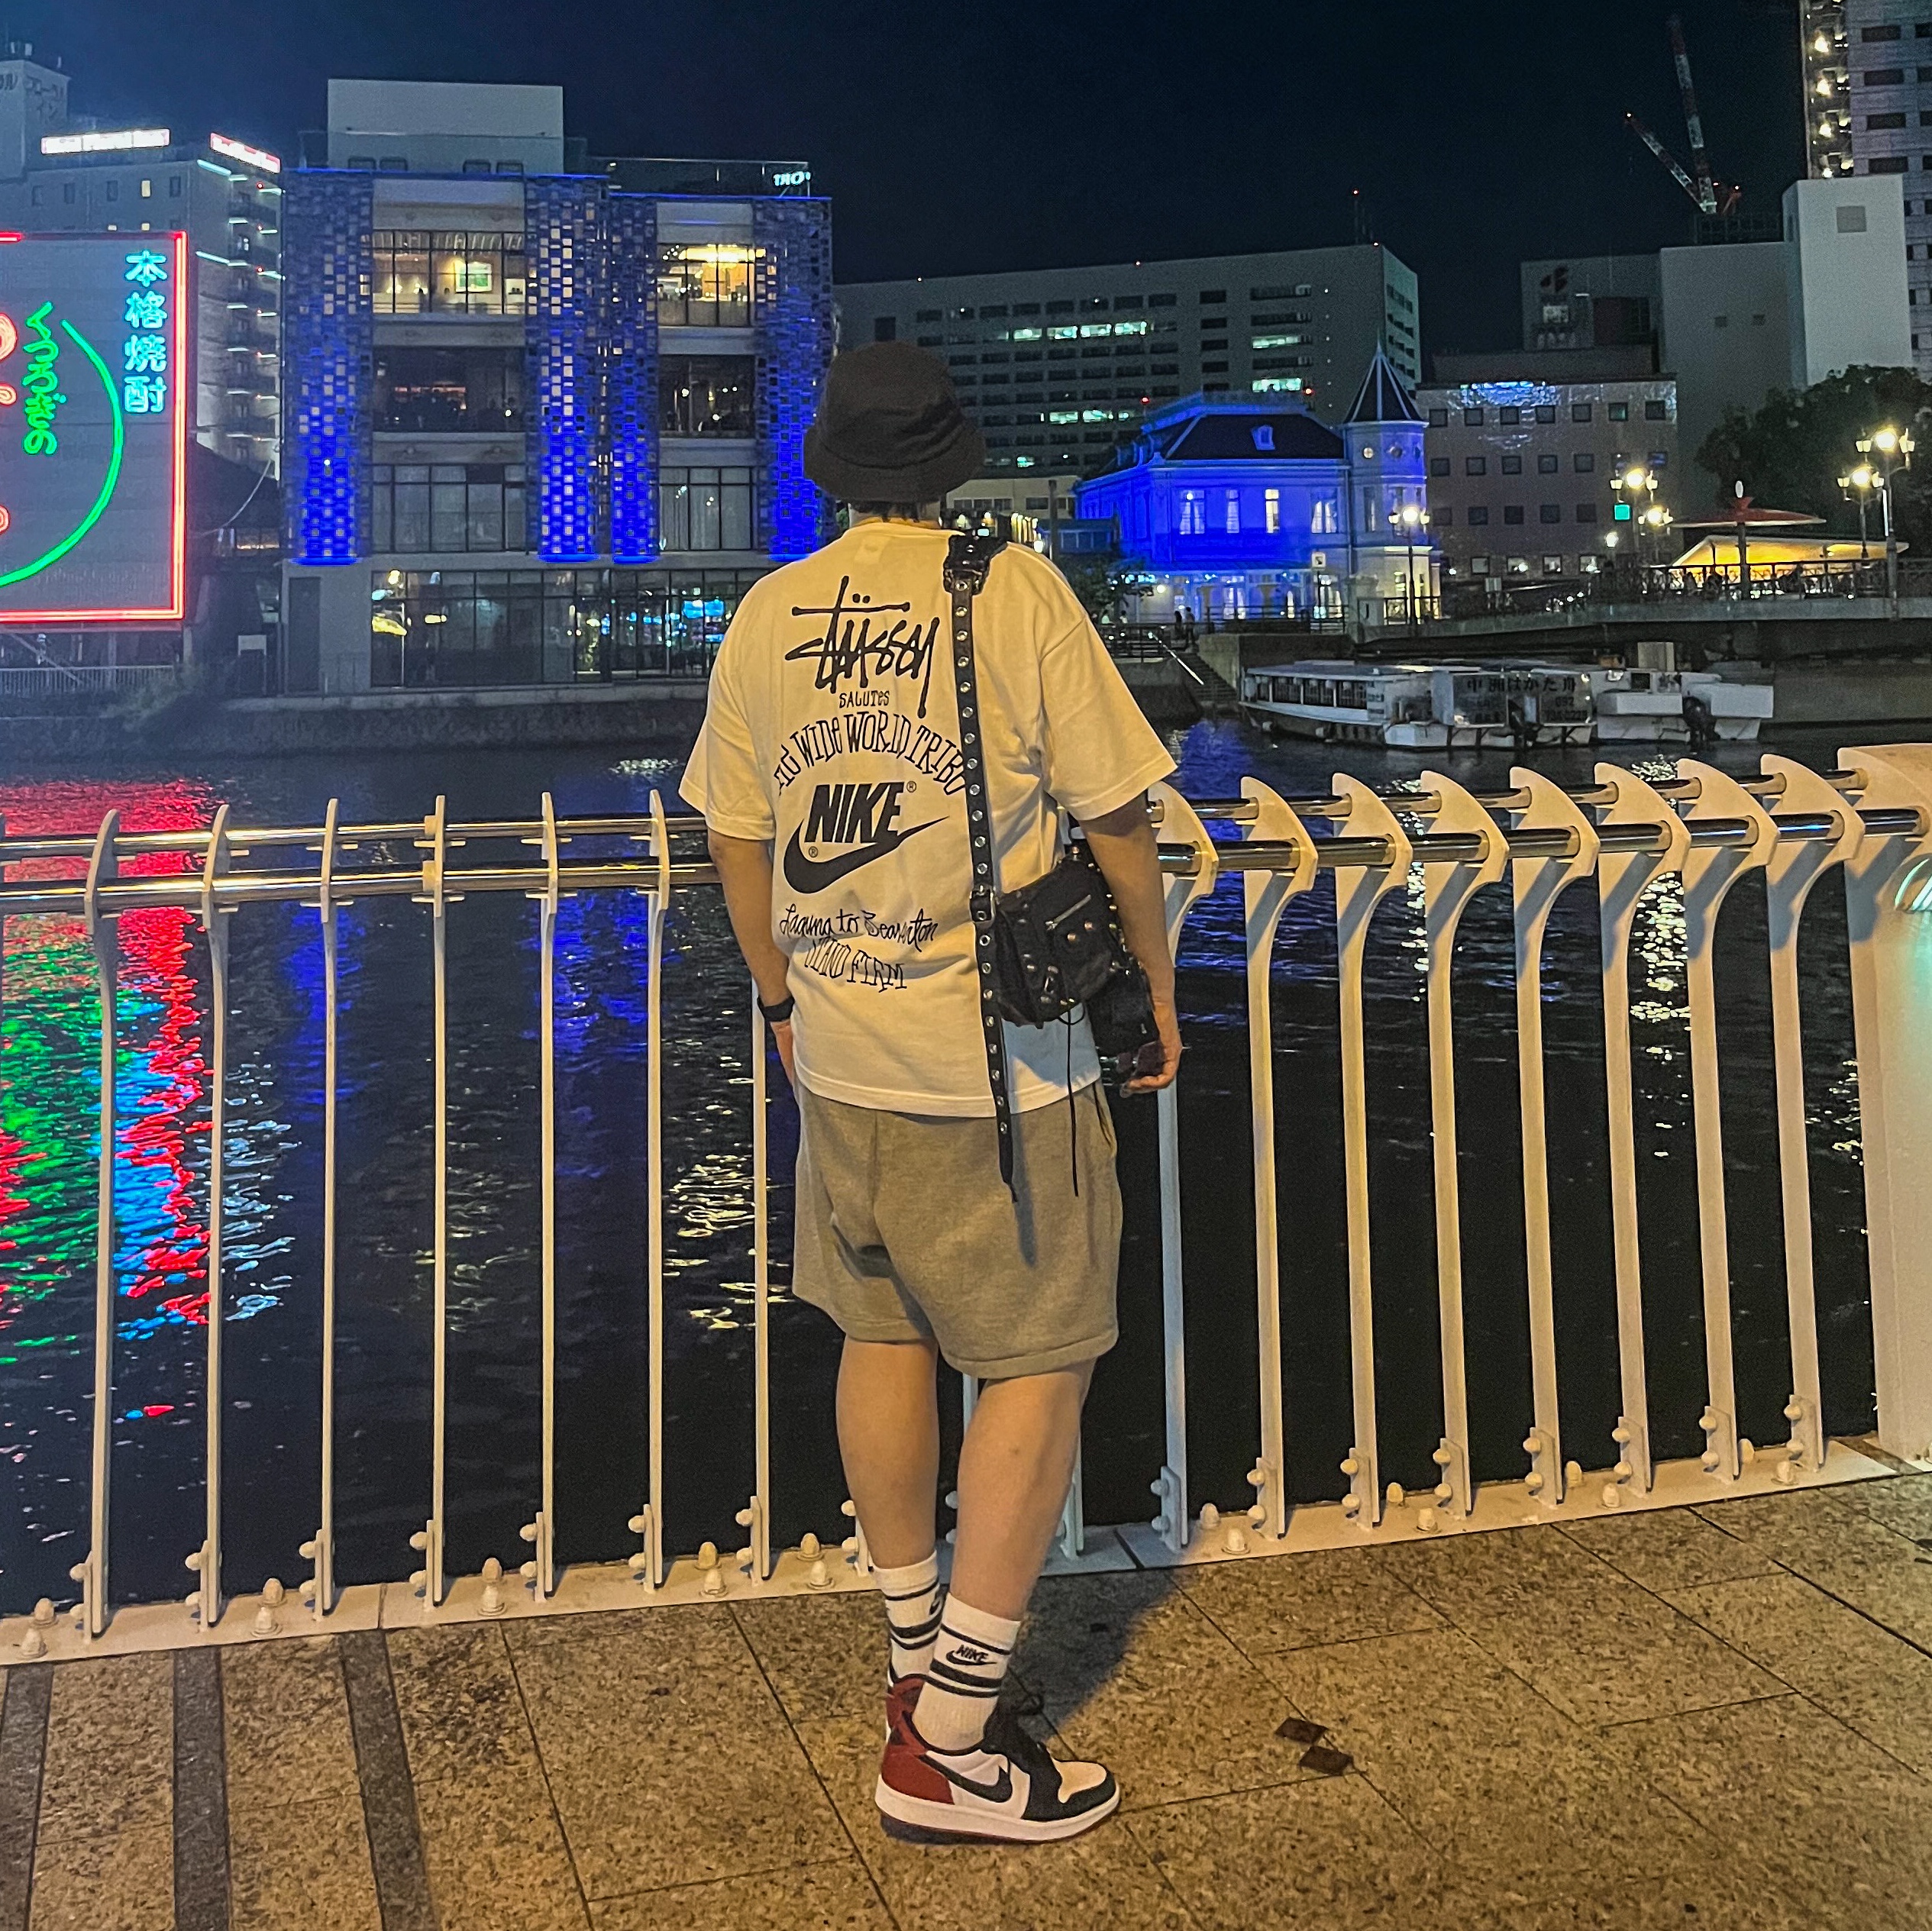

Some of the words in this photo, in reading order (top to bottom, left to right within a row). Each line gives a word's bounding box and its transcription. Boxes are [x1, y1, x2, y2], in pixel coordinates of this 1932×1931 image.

[124, 249, 168, 413] 本格焼酎
[22, 301, 66, 455] くつろぎの
[804, 781, 905, 843] NIKE
[836, 908, 859, 933] to
[846, 949, 907, 993] FIRM
[956, 1645, 988, 1661] NIKE
